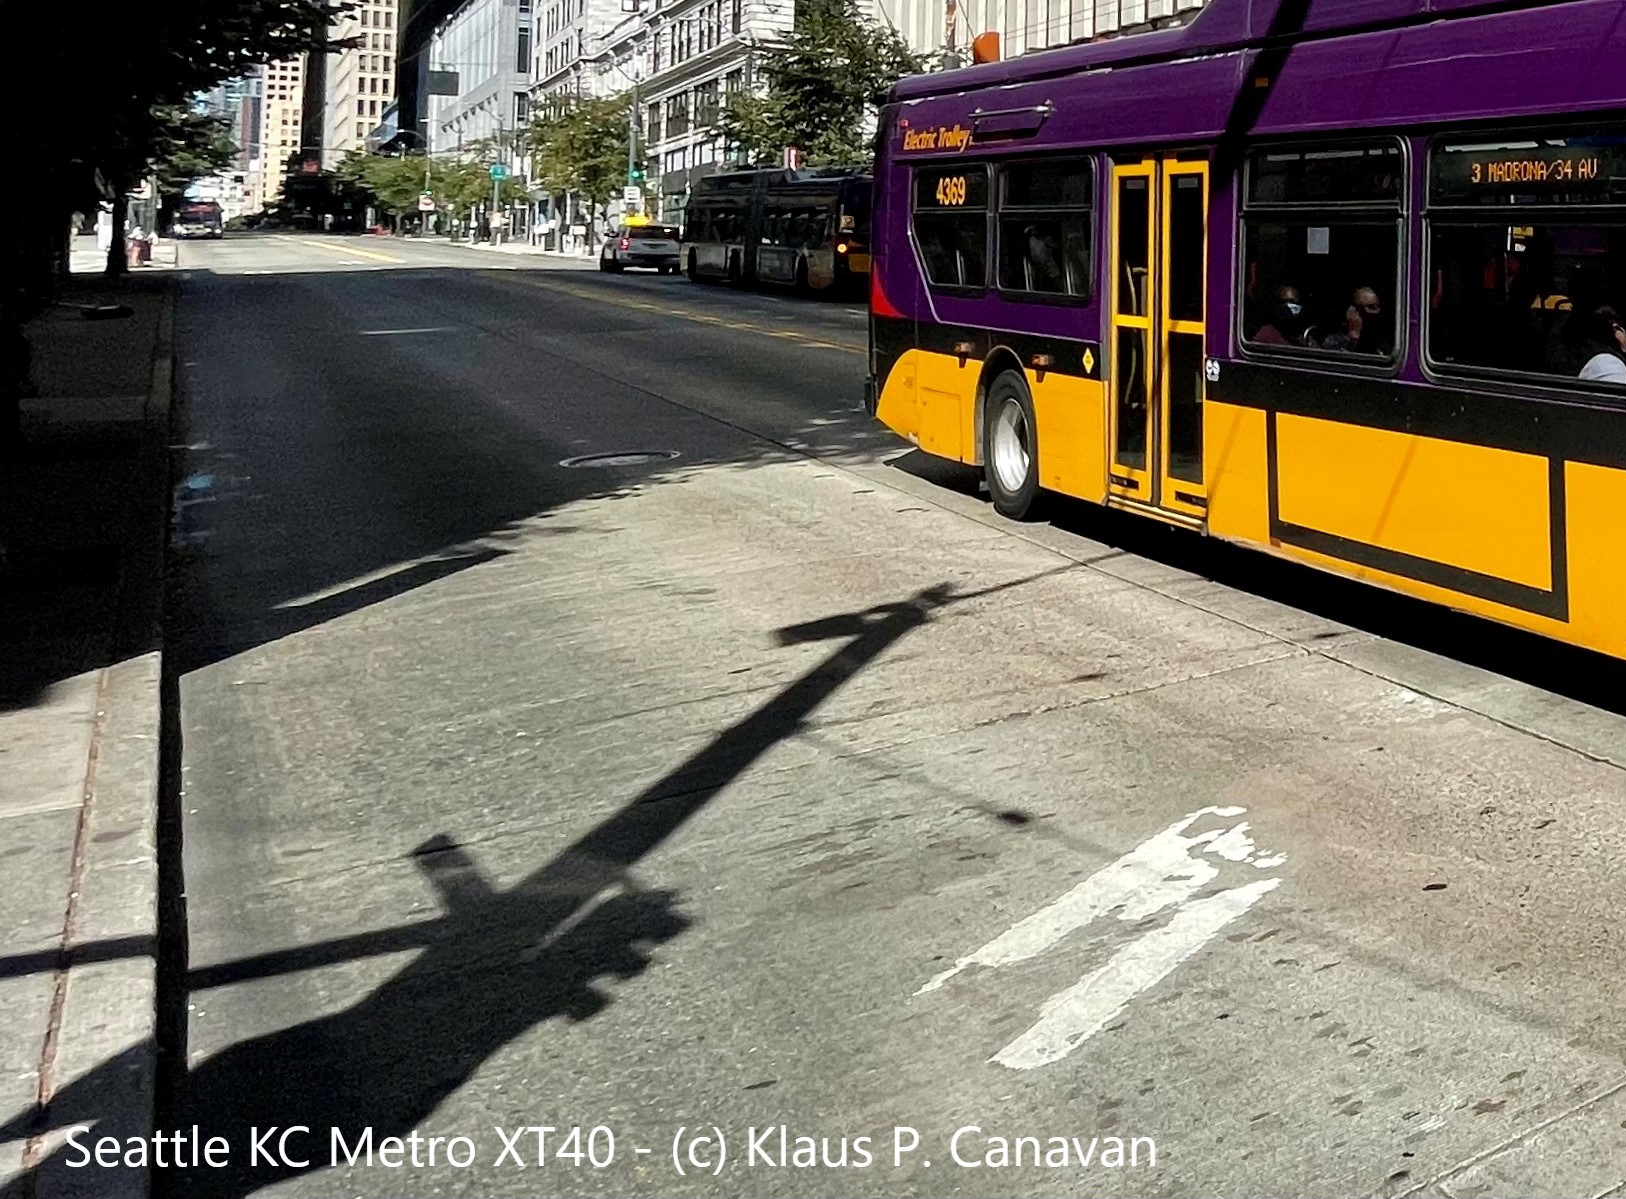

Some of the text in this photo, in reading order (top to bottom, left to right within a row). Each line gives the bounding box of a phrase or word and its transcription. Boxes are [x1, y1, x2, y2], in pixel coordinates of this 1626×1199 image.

[903, 124, 971, 153] Electric Trolley
[1470, 158, 1598, 183] 3 MADRONA/34 AV
[935, 176, 966, 206] 4369
